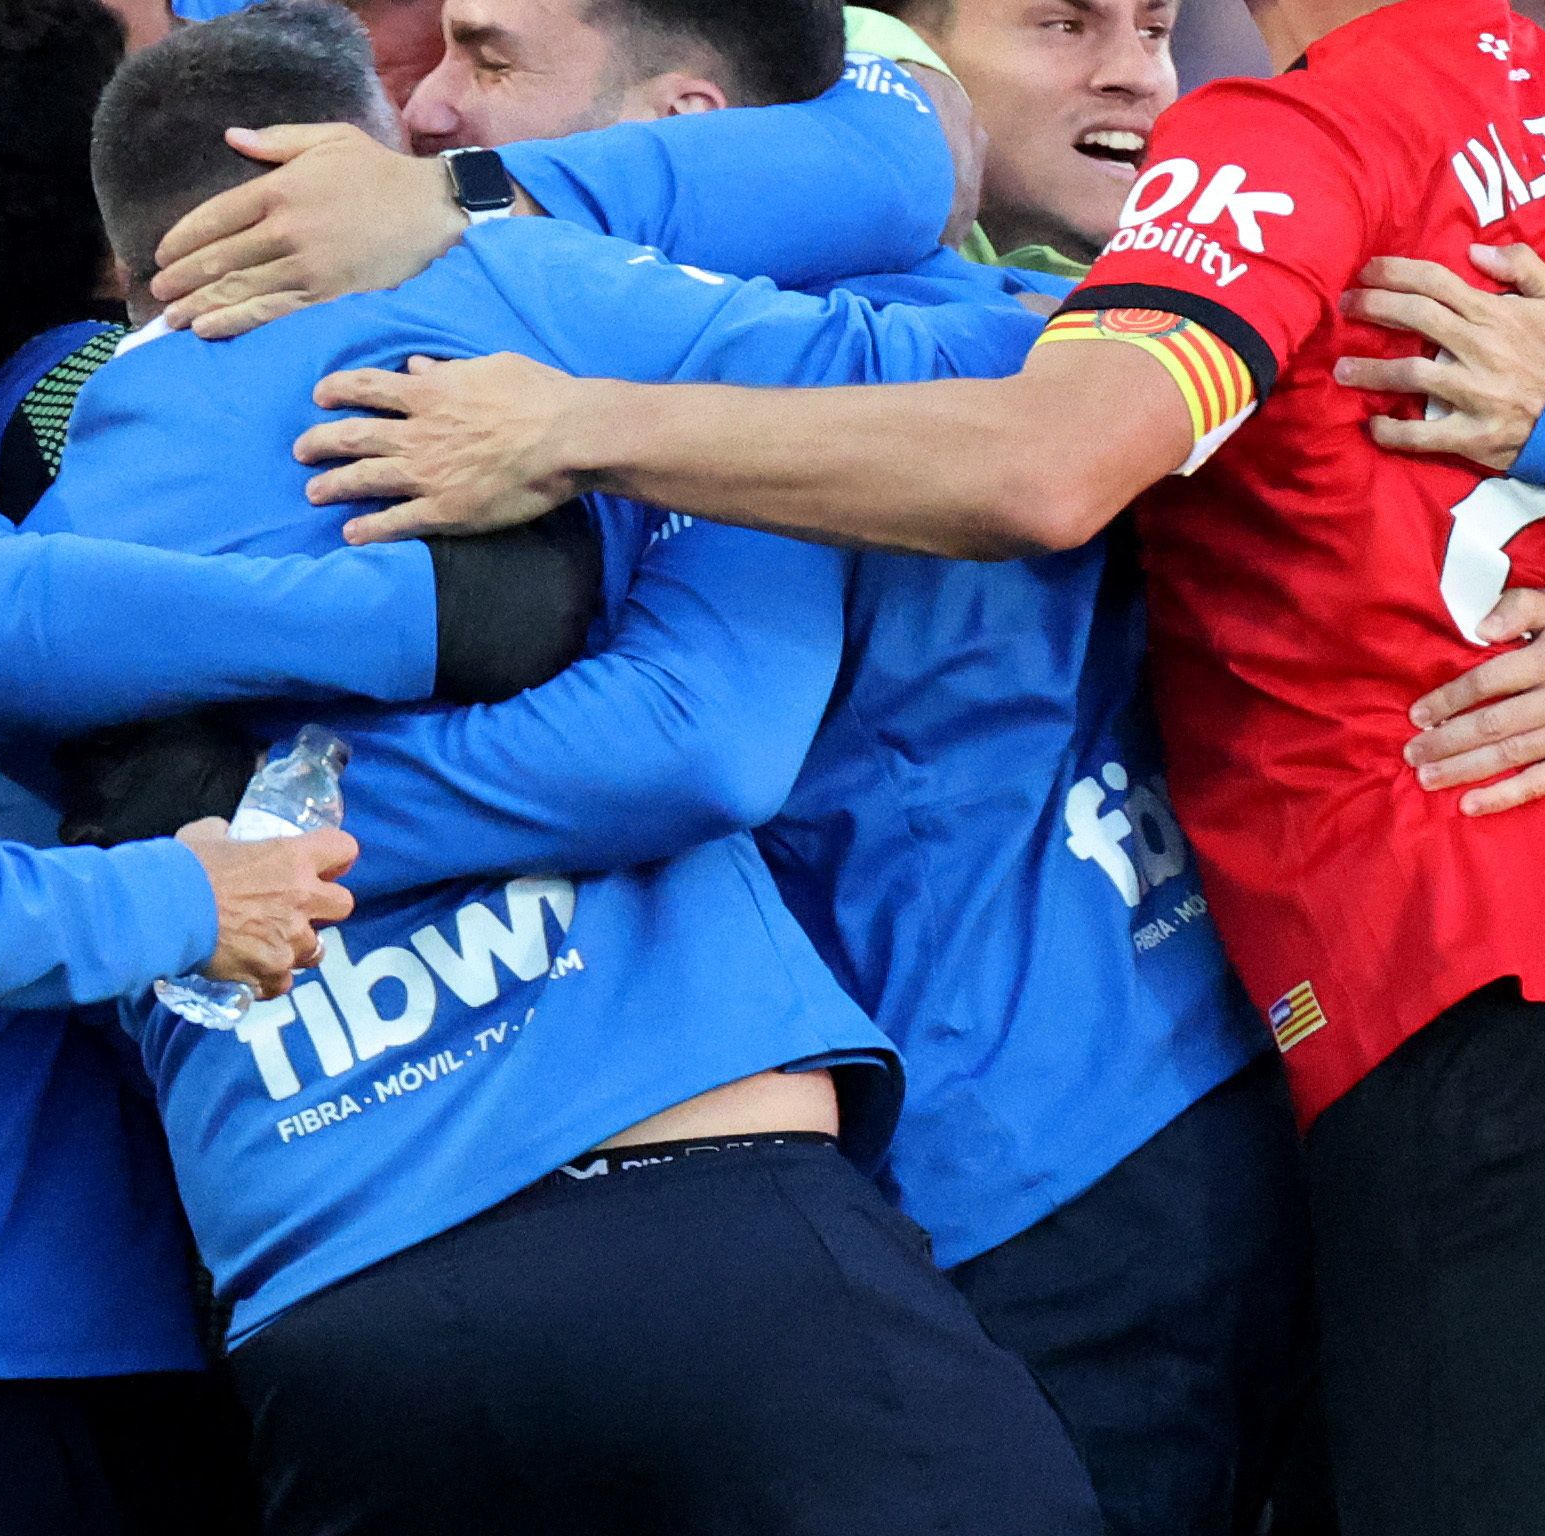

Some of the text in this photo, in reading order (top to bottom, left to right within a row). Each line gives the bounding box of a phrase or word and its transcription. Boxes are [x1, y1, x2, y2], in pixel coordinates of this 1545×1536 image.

[1119, 157, 1295, 253] OK
[276, 1021, 508, 1145] FIBRA MÓVIL TV
